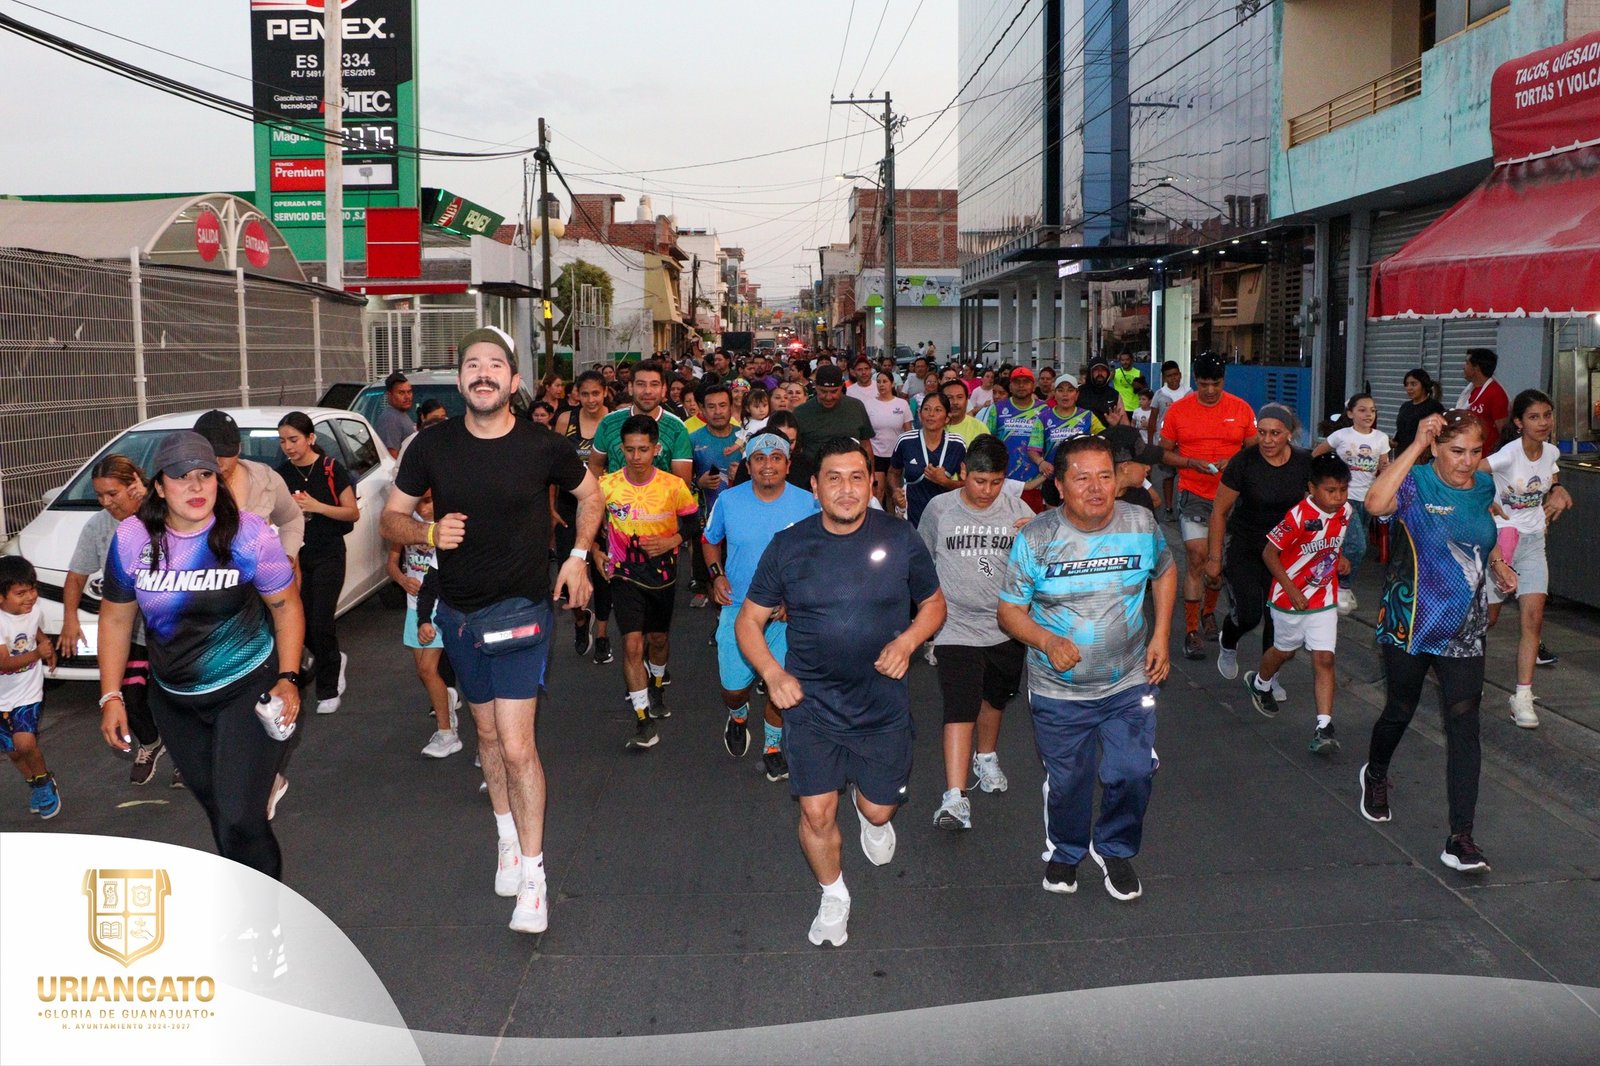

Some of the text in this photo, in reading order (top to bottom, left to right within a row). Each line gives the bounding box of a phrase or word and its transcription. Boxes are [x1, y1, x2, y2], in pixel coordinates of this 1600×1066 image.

[296, 53, 370, 68] ES 334
[1515, 60, 1550, 85] TACOS,
[273, 94, 305, 102] Gasolinas
[1515, 82, 1554, 109] TORTAS
[1557, 79, 1564, 97] Y
[275, 167, 325, 178] Premium
[274, 212, 309, 221] SERVICIO
[312, 212, 327, 221] DEL
[197, 228, 219, 244] SALIDA
[245, 235, 269, 254] ENTRADA
[955, 525, 1007, 535] CHICAGO
[946, 534, 1015, 550] WHITE SOX
[1300, 537, 1343, 555] DIABLOS
[1062, 556, 1129, 571] FIERROS
[135, 568, 240, 592] URIANGATO
